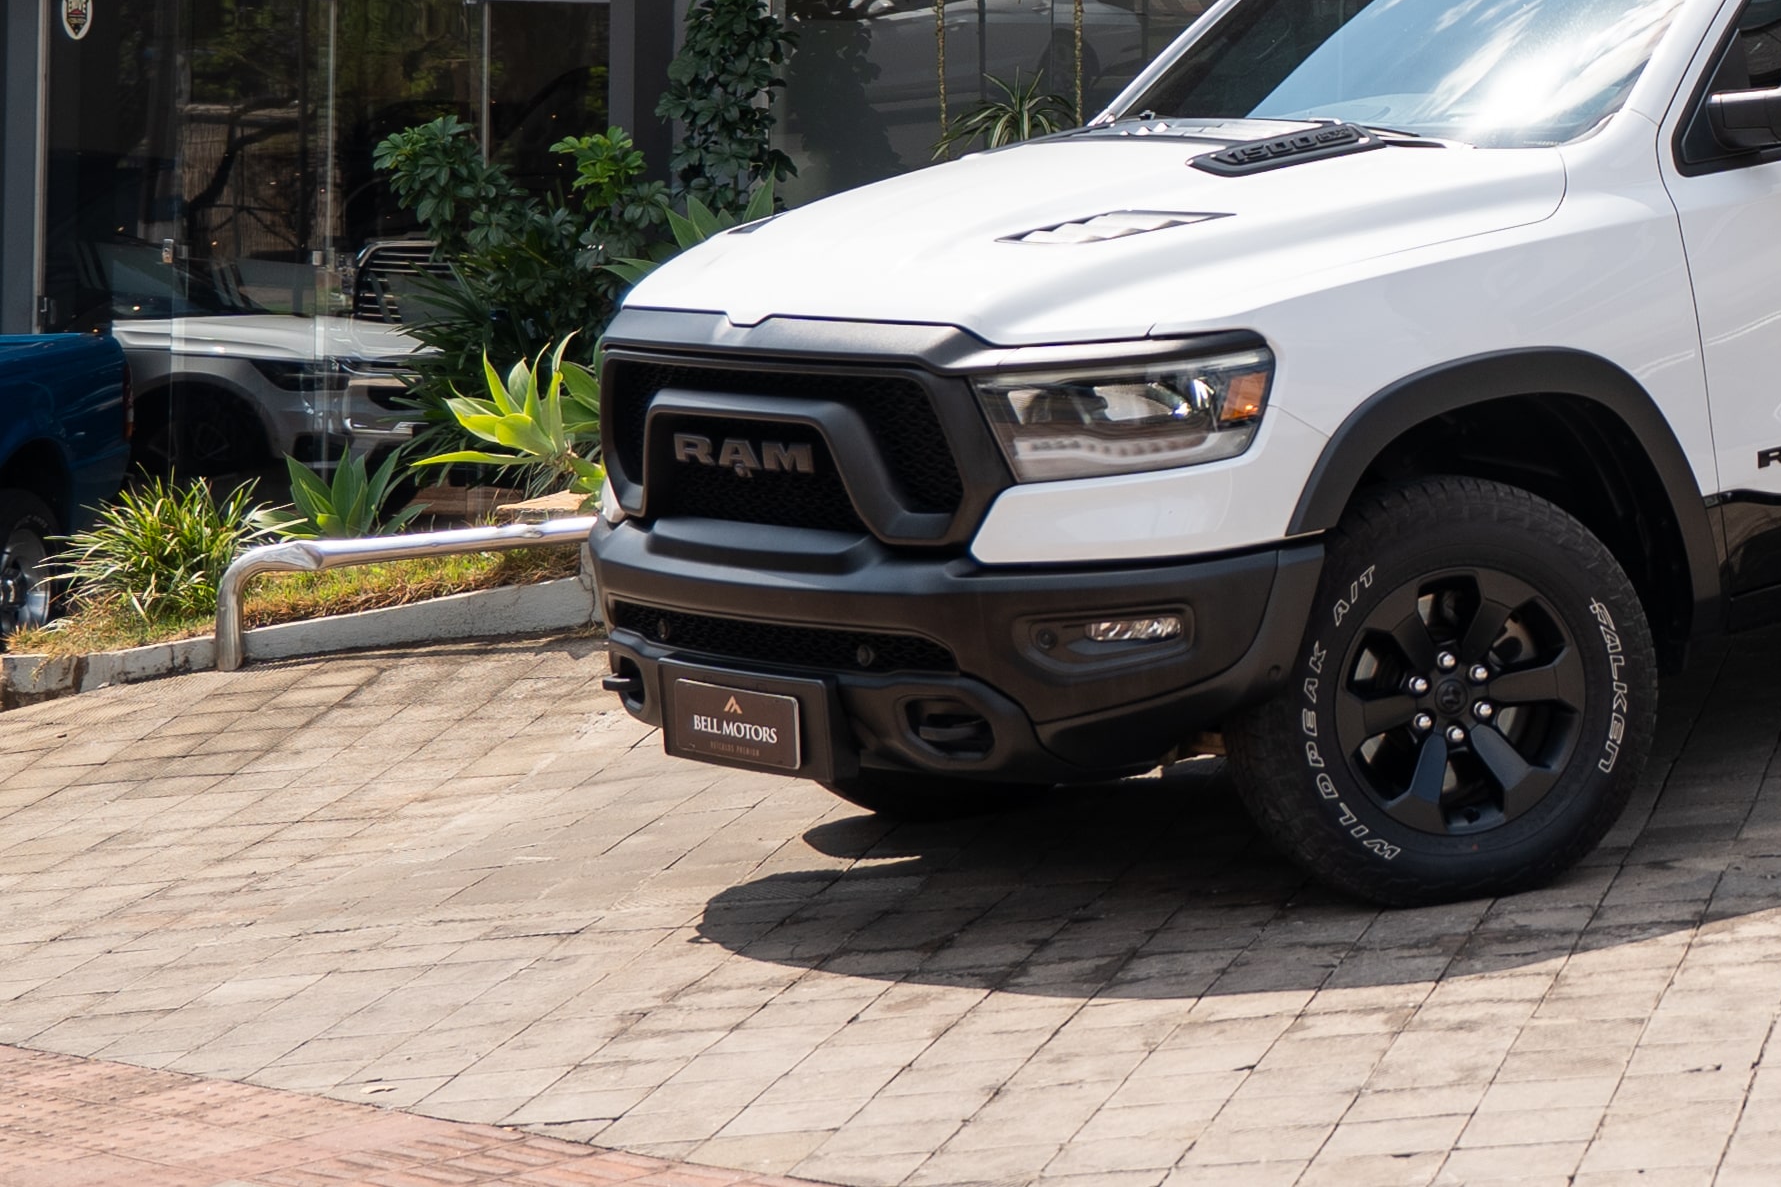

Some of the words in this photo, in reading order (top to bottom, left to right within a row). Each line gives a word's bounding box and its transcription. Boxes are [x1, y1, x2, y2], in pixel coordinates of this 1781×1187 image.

[674, 433, 815, 474] RAM
[693, 714, 721, 734] BELL
[722, 720, 778, 744] MOTORS
[1589, 597, 1627, 773] FALKEN
[1302, 640, 1401, 860] WILDPEAK
